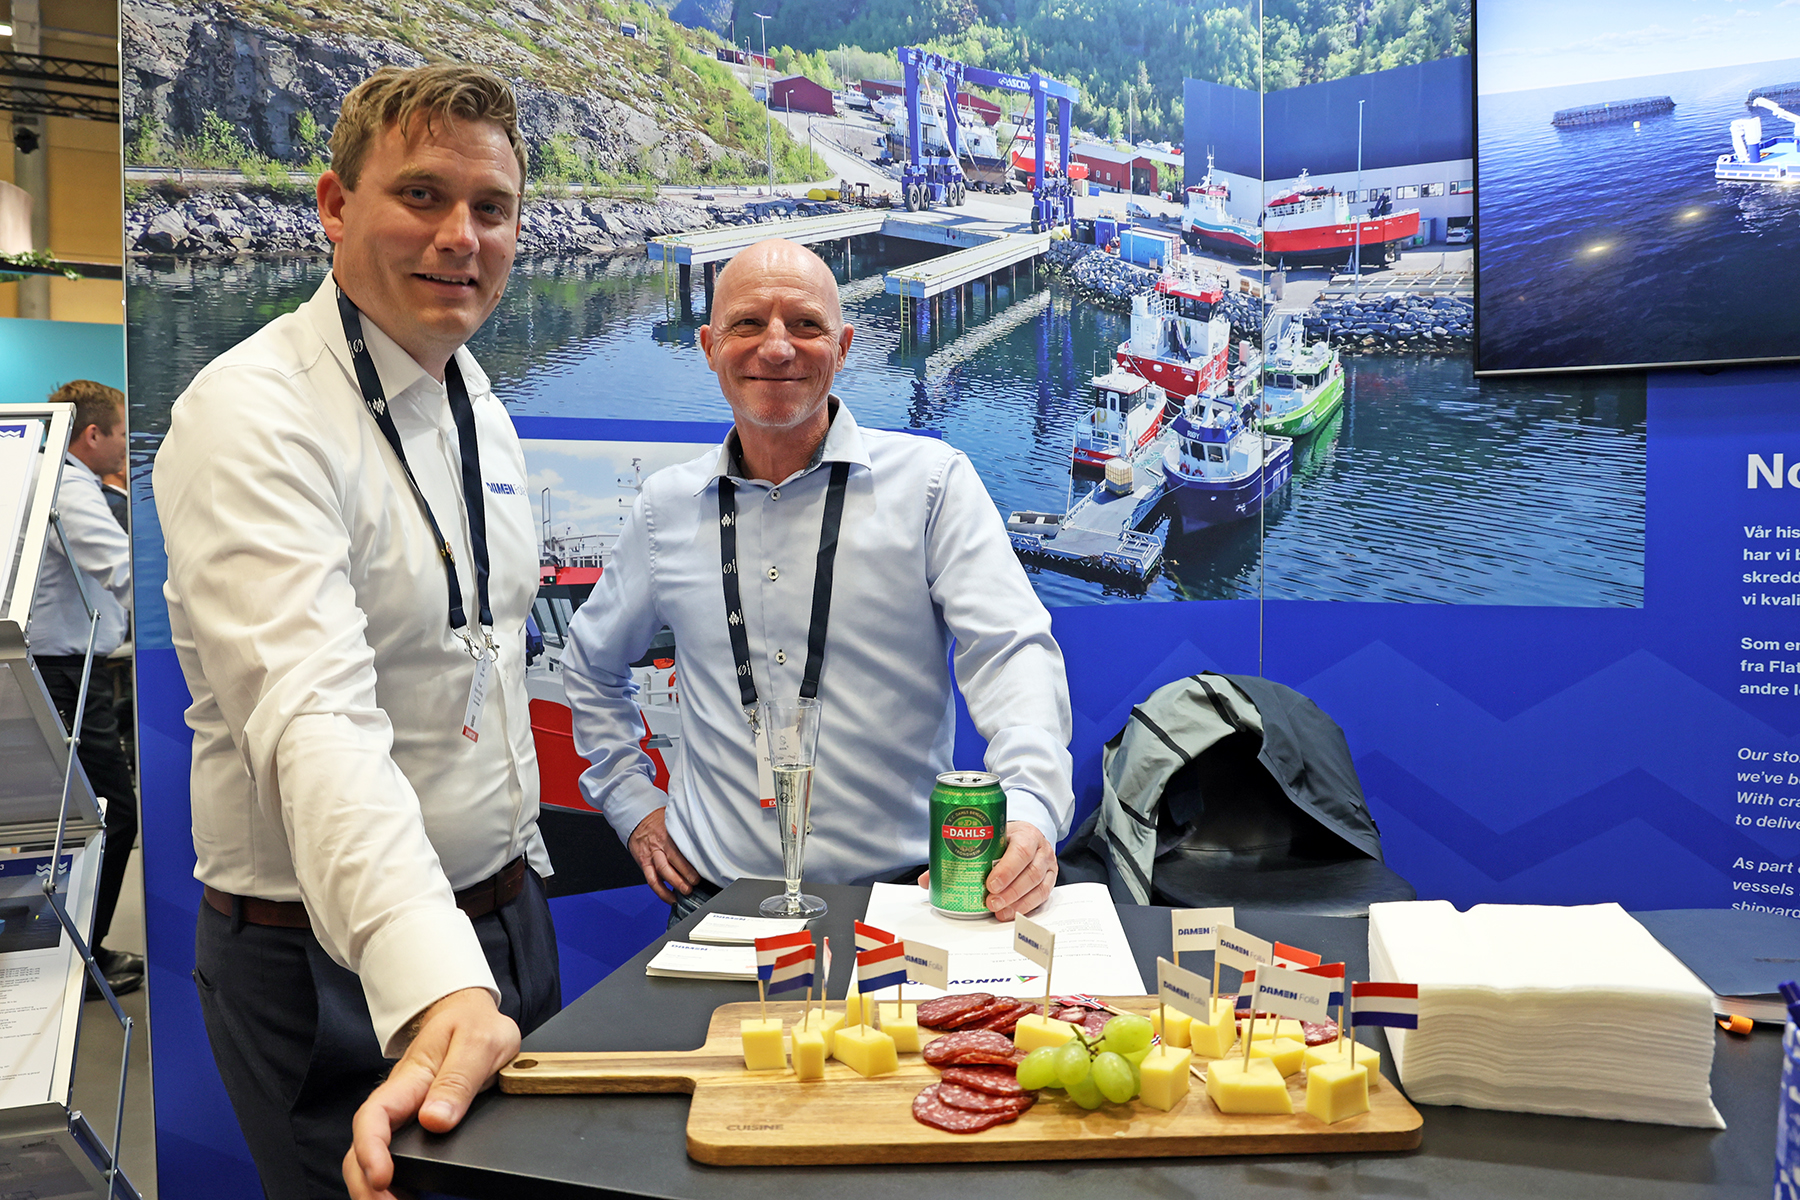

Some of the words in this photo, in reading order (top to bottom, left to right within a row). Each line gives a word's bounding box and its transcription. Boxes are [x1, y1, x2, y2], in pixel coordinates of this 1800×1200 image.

[1743, 525, 1772, 538] Vår
[1776, 526, 1800, 538] his
[1743, 548, 1771, 560] har
[1776, 548, 1790, 560] vi
[1742, 570, 1800, 583] skredd
[1742, 593, 1756, 605] vi
[1740, 637, 1780, 650] Som
[1740, 659, 1764, 672] fra
[1739, 682, 1790, 696] andre
[1737, 747, 1769, 761] Our
[1773, 750, 1800, 763] sto
[1737, 791, 1774, 806] With
[1735, 814, 1752, 826] to
[950, 828, 986, 838] DAHLS
[1732, 856, 1755, 870] As
[1757, 862, 1794, 874] part
[1732, 881, 1794, 896] vessels
[1178, 927, 1210, 936] DAMEN
[1018, 932, 1039, 950] DAMEN
[1220, 939, 1249, 957] DAMEN
[904, 954, 928, 967] AMEN
[1163, 980, 1190, 999] DAMEN
[1259, 985, 1298, 1001] DAMEN
